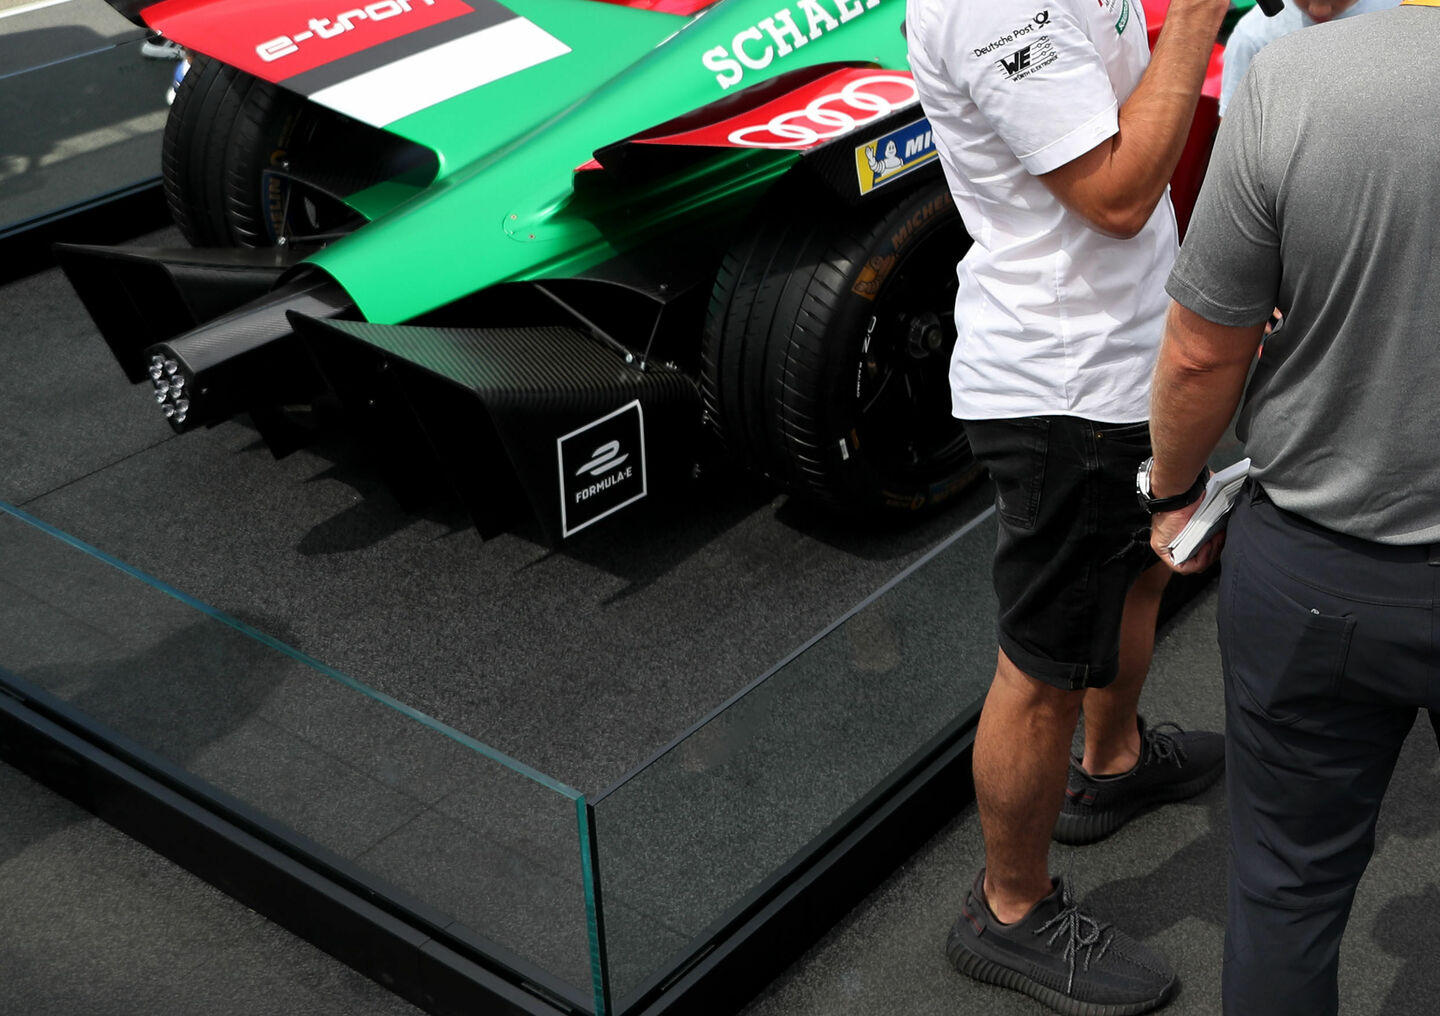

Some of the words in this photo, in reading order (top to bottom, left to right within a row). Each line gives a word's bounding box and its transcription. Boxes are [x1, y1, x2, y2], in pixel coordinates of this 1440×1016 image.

[973, 33, 1015, 57] Deutsche
[1012, 23, 1034, 39] Post
[1000, 45, 1031, 75] WE
